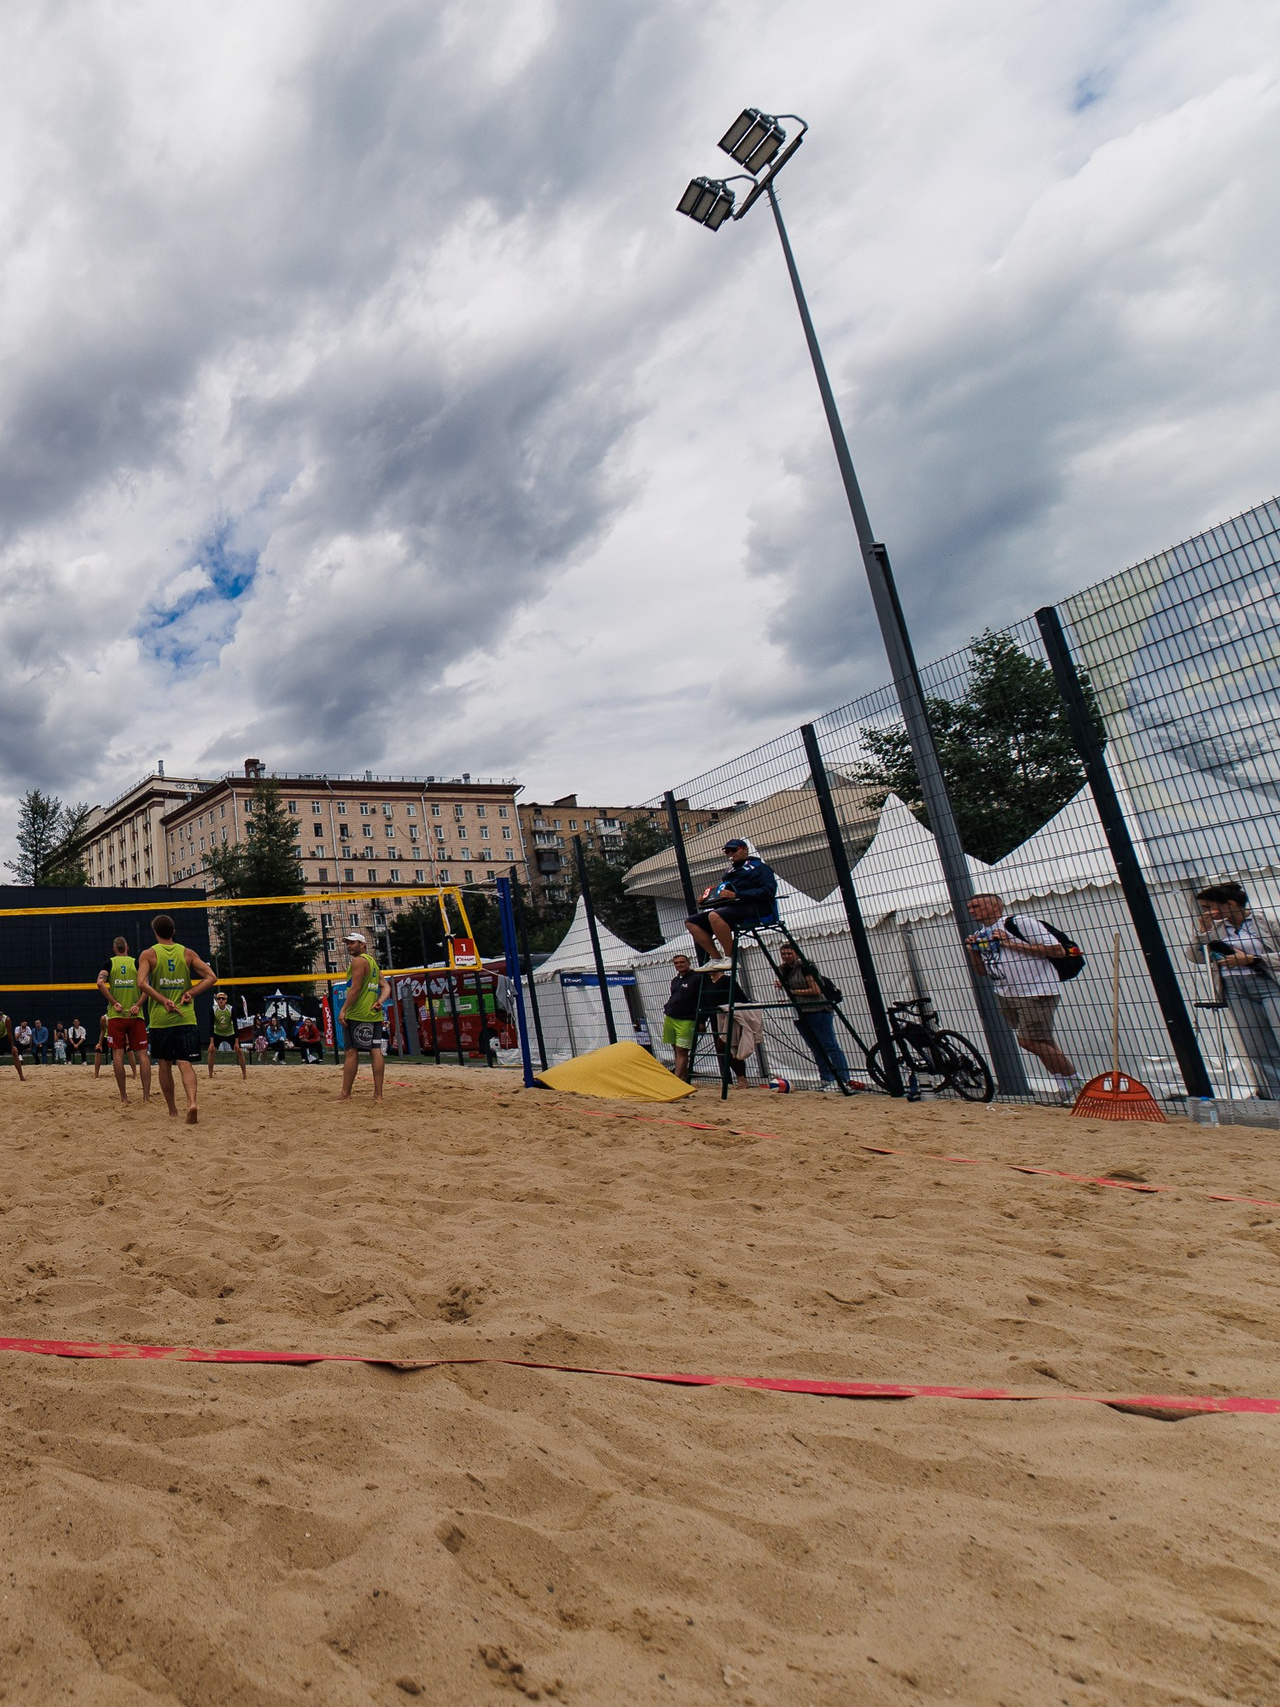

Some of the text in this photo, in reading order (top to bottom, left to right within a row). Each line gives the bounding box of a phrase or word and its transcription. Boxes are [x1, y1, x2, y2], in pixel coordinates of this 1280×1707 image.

[461, 943, 466, 952] 1
[120, 965, 126, 974] 3
[167, 959, 175, 972] 5
[220, 1015, 226, 1024] 2
